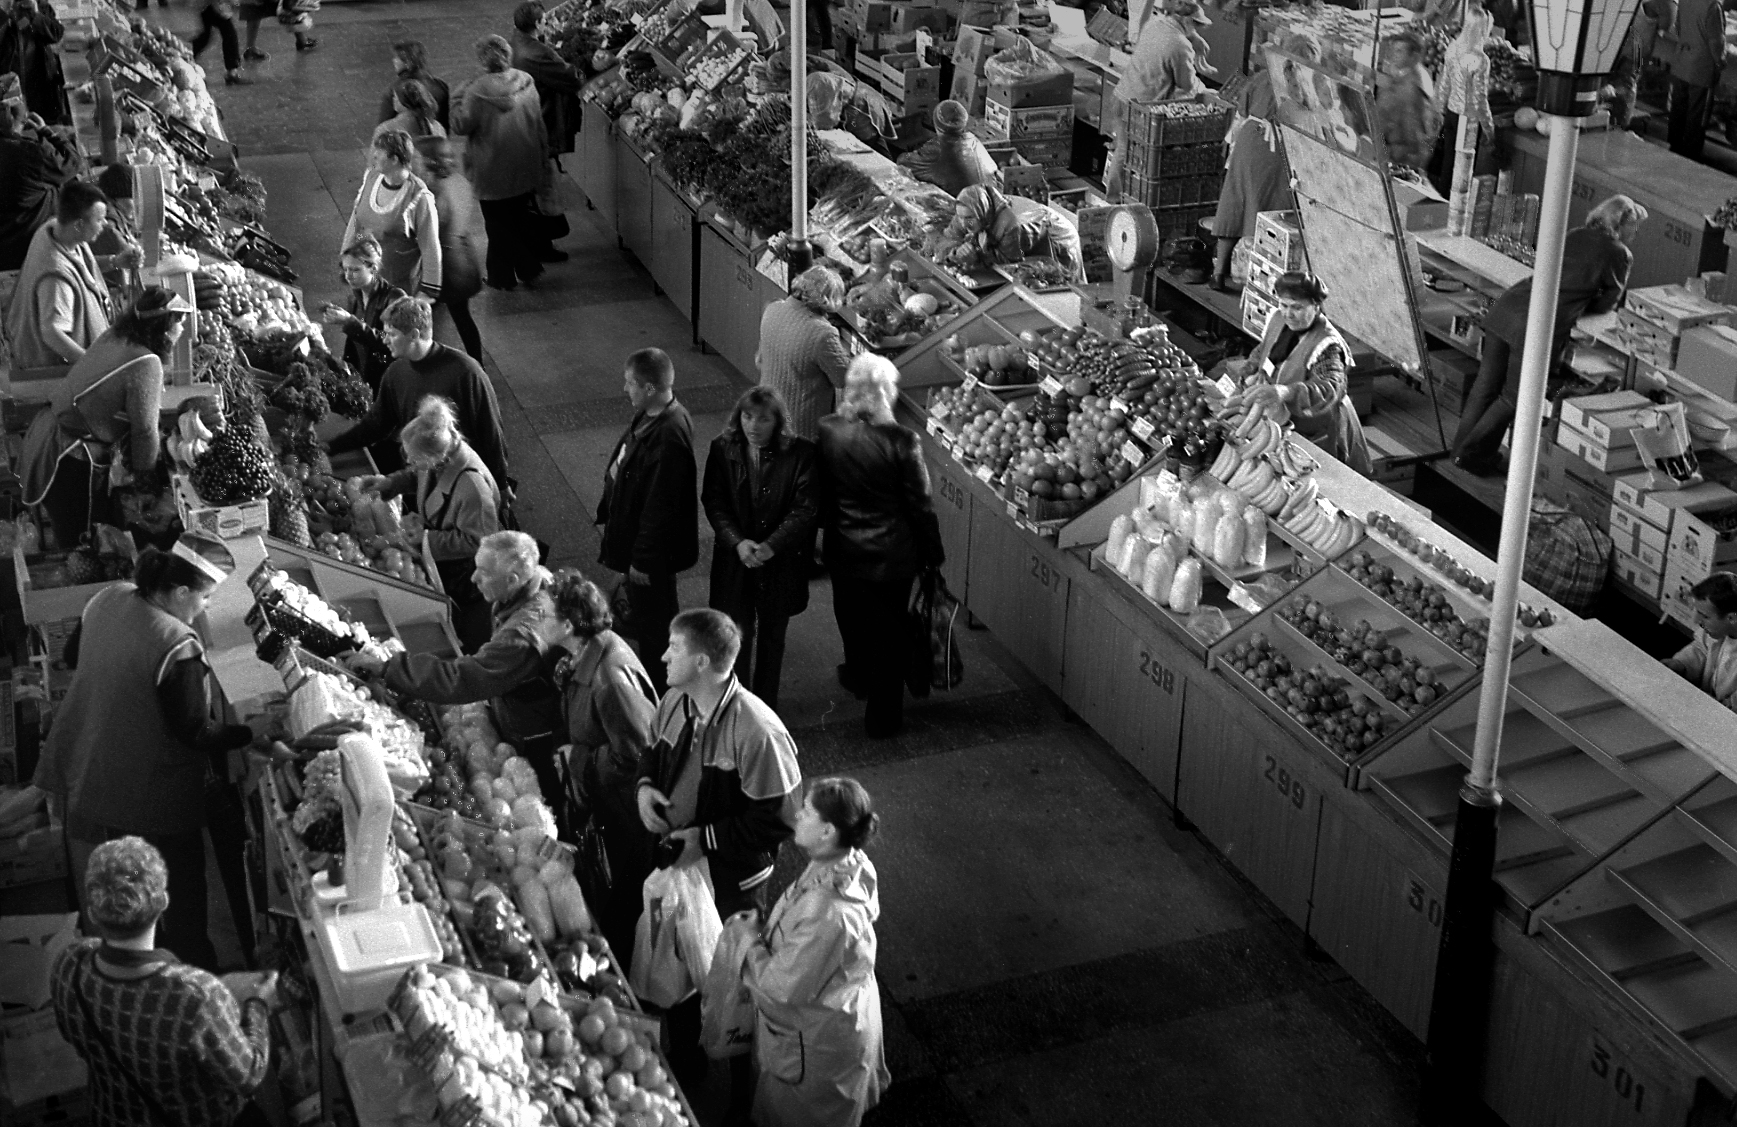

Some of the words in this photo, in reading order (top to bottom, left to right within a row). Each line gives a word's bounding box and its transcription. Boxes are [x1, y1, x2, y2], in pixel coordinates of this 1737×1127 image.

[1571, 181, 1595, 201] 237
[1664, 222, 1692, 247] 238
[940, 476, 963, 510] 296
[1031, 555, 1060, 593] 297
[1139, 651, 1174, 695] 298
[1264, 754, 1305, 810] 299
[1407, 879, 1443, 928] 30
[1591, 1043, 1645, 1114] 301
